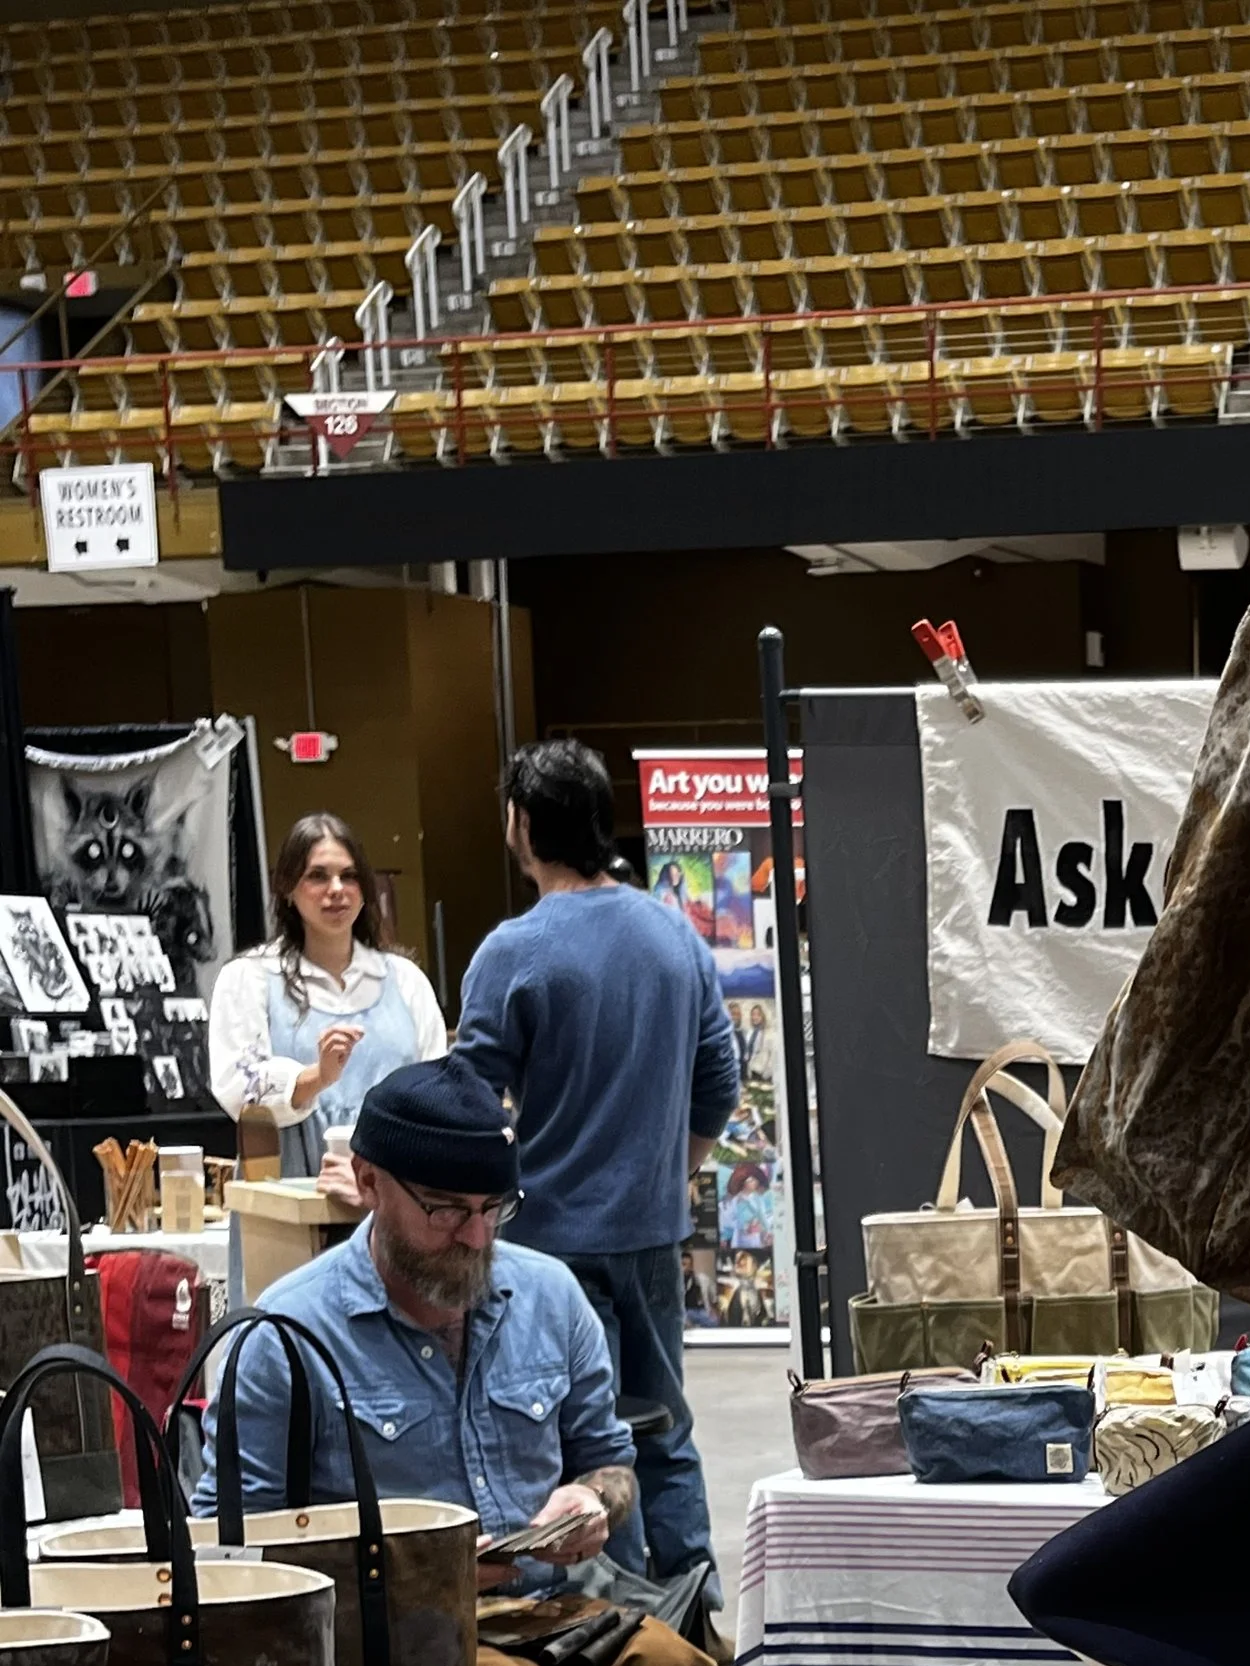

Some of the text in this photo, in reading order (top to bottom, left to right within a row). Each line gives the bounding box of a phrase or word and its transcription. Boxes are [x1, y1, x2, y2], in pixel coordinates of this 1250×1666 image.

[58, 477, 136, 501] WOMEN'S
[57, 502, 143, 529] RESTROOM
[649, 769, 690, 794] Art
[691, 774, 742, 800] you
[649, 798, 698, 811] because
[699, 800, 724, 815] you
[647, 828, 743, 847] MARRERO
[987, 799, 1171, 929] Ask
